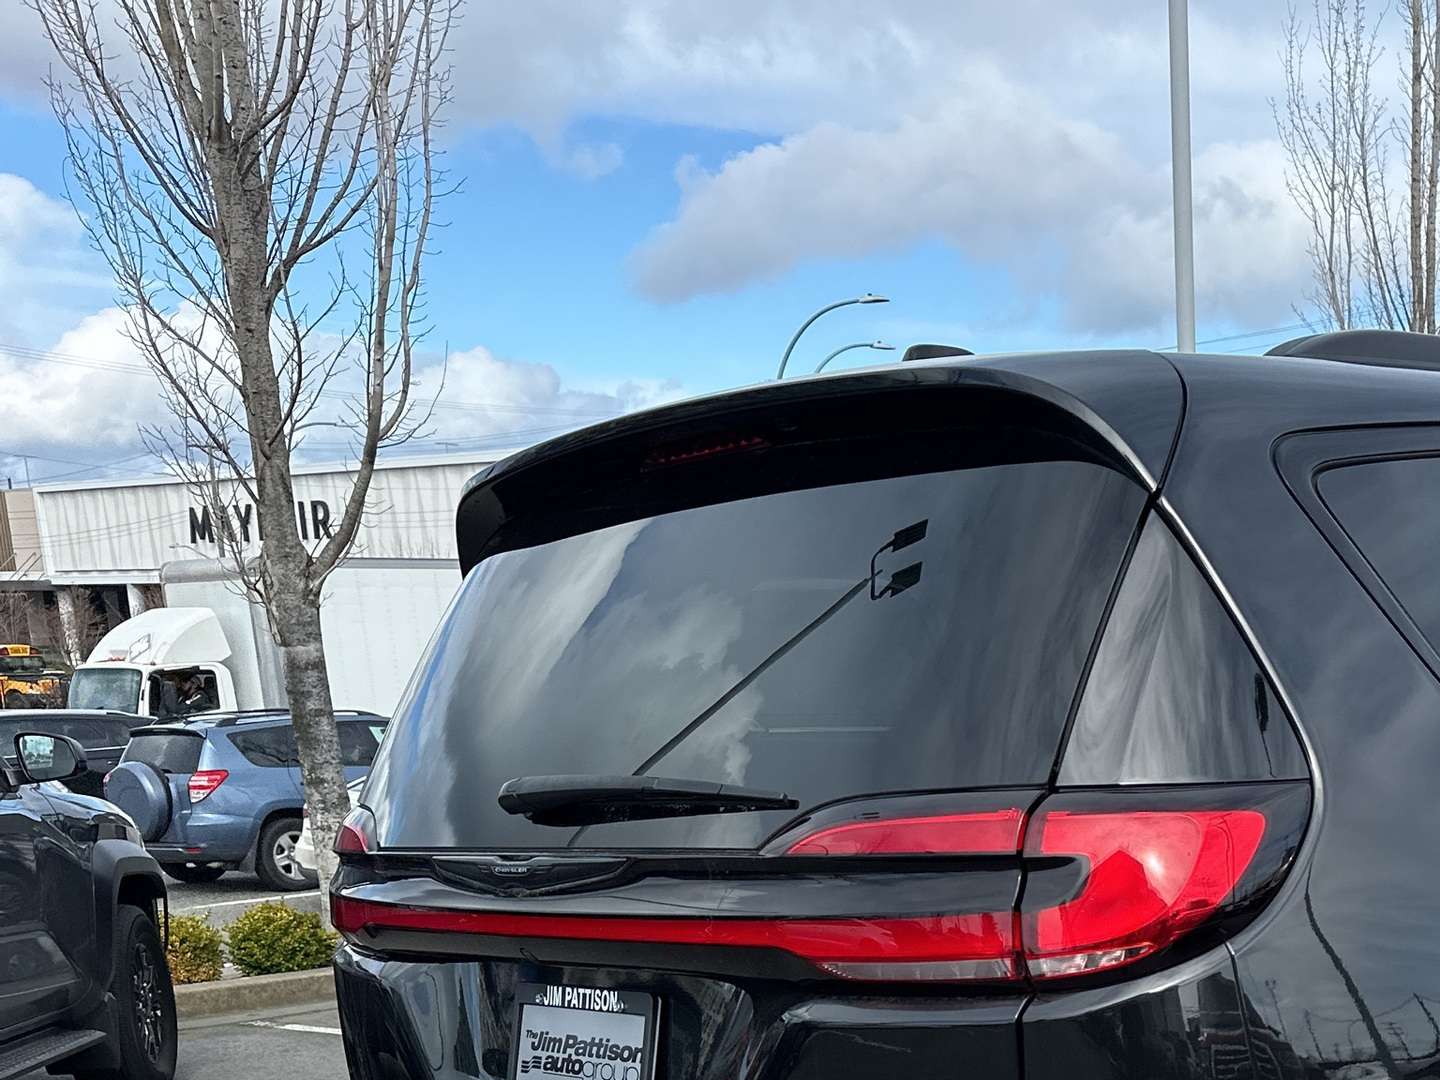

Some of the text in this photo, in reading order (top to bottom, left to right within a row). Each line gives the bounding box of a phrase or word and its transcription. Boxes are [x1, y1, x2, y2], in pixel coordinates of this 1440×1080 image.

[189, 500, 332, 544] MYIR
[543, 985, 618, 1012] JIM PATTISON
